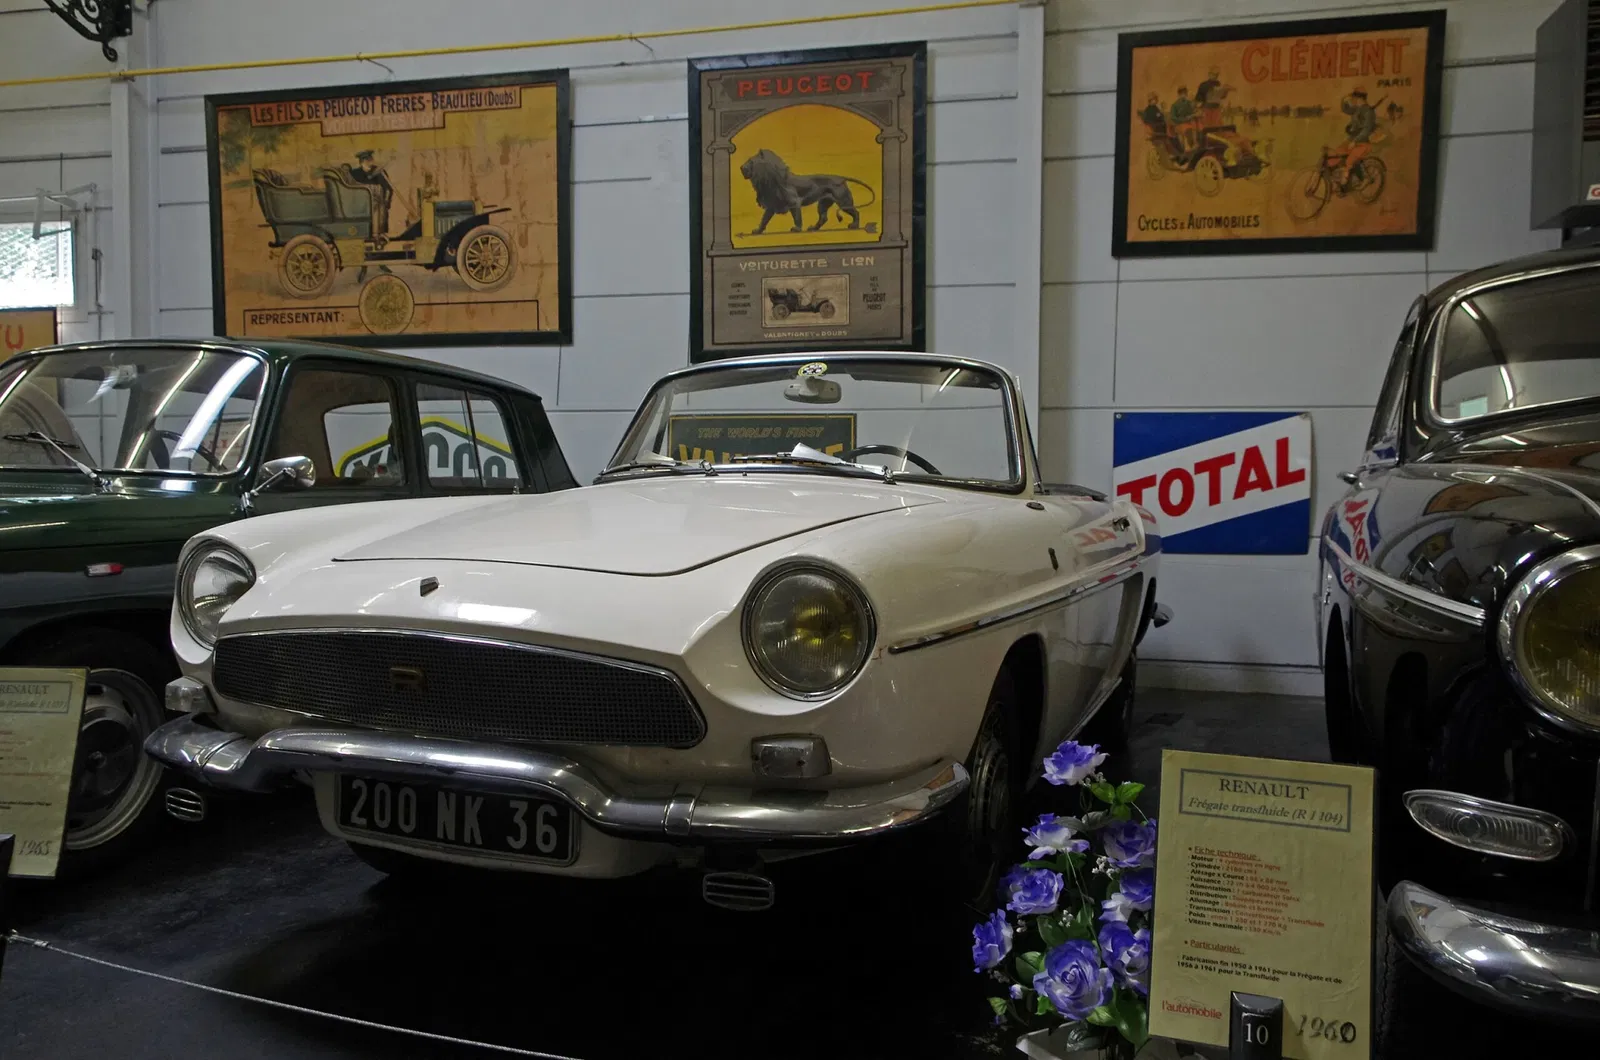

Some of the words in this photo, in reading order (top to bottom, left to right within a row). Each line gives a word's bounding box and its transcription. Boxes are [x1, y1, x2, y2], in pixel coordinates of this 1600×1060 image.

[1241, 38, 1411, 84] CLÉMENT
[737, 71, 876, 97] PEUGEOT
[1377, 77, 1412, 88] PARIS
[254, 103, 273, 122] LES
[277, 102, 304, 122] FILS
[307, 104, 320, 120] DE
[323, 96, 376, 118] PEUGEOT
[1138, 214, 1178, 231] CYCLES
[1187, 213, 1260, 229] AUTOMOBILES
[739, 258, 828, 272] VOITURETTE
[842, 256, 875, 267] LION
[727, 426, 782, 439] WORLD'S
[1117, 436, 1306, 517] TOTAL
[1219, 778, 1310, 800] RENAULT
[1188, 797, 1229, 812] Frégate
[1231, 803, 1290, 818] transfluide
[350, 778, 417, 834] 200
[436, 791, 484, 845] NK
[505, 799, 558, 854] 36
[1194, 845, 1215, 856] Fiche
[1191, 855, 1214, 863] Moteur
[1190, 875, 1221, 885] Puissance
[1222, 873, 1244, 881] Course
[1189, 890, 1228, 900] Distribution
[1190, 883, 1232, 893] Alimentation
[1189, 897, 1220, 907] Allumage
[1189, 904, 1231, 914] Transmission
[1188, 911, 1206, 919] Poids
[1188, 918, 1212, 927] Vitesse
[1213, 921, 1244, 931] maximale
[1182, 954, 1219, 965] Fabrication
[1231, 962, 1247, 970] 1950
[1255, 965, 1271, 973] 1961
[1272, 969, 1289, 977] pour
[1297, 972, 1323, 982] Frégate
[1200, 964, 1216, 972] 1961
[1218, 968, 1234, 976] pour
[1243, 971, 1280, 982] Transfluide
[1162, 999, 1223, 1020] l'automobile
[1245, 1023, 1269, 1045] 10
